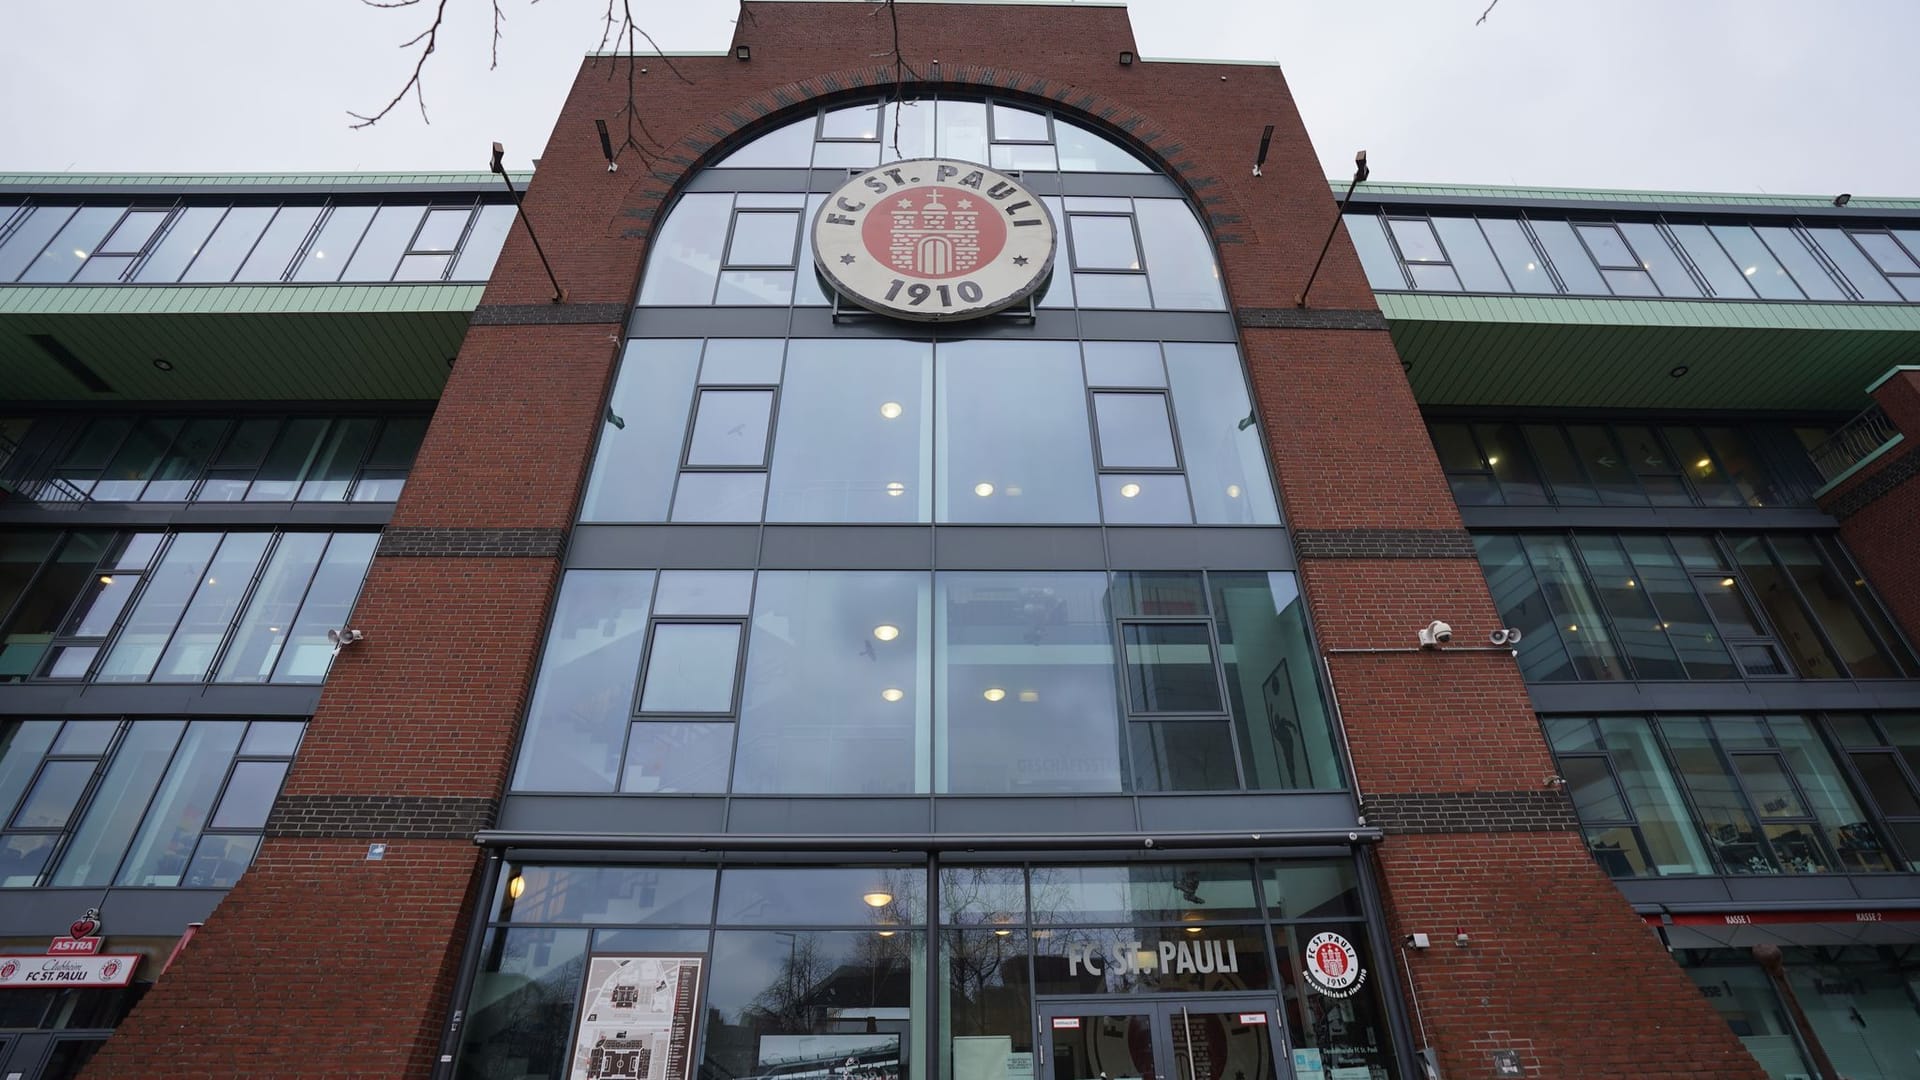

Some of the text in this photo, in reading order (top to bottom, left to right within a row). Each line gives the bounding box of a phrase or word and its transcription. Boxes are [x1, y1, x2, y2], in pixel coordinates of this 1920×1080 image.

[825, 164, 1042, 228] FC ST. PAULI
[884, 278, 984, 307] 1910
[1725, 915, 1752, 924] KASSE 1
[1856, 912, 1882, 922] KASSE 2
[53, 941, 93, 950] ASTRA
[1308, 934, 1355, 959] FC ST. PAULI
[1068, 939, 1239, 977] FC ST. PAULI
[25, 971, 88, 981] FC ST. PAULI
[1327, 977, 1347, 987] 1910
